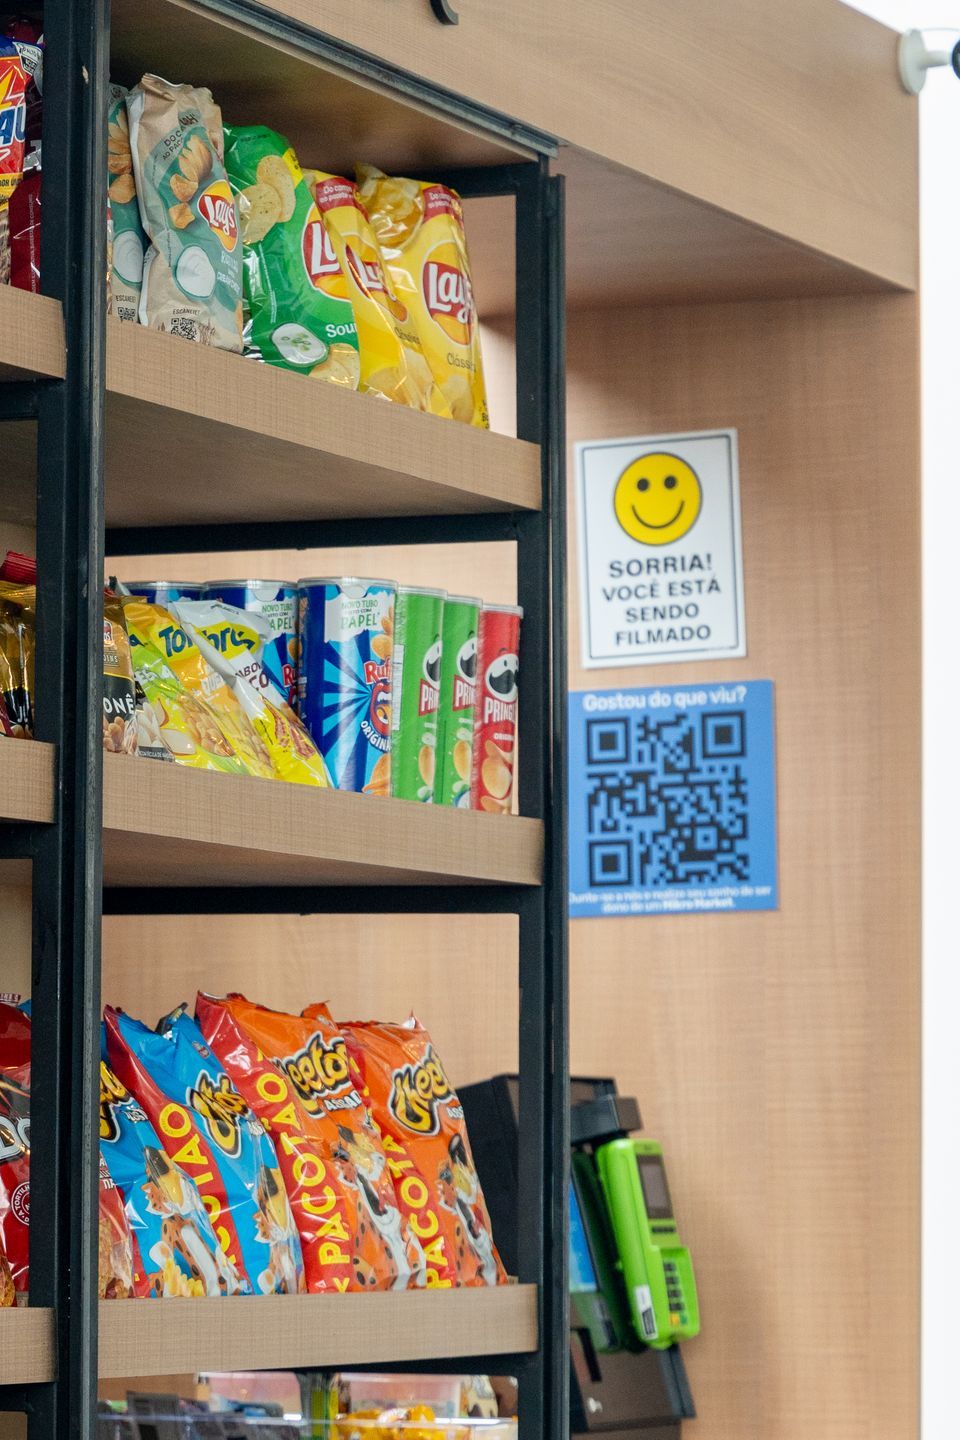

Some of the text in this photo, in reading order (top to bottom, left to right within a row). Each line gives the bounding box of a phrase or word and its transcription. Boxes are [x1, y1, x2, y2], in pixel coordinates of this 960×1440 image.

[429, 263, 474, 324] Lay
[609, 553, 713, 578] SORRIA!
[602, 573, 722, 602] VOCÊ ESTÁ
[270, 617, 292, 630] APEL
[626, 603, 700, 624] SENDO
[615, 625, 712, 647] FILMADO
[103, 695, 135, 715] ONÊ
[484, 697, 515, 724] PRING
[582, 686, 747, 712] Gostou do que viu?
